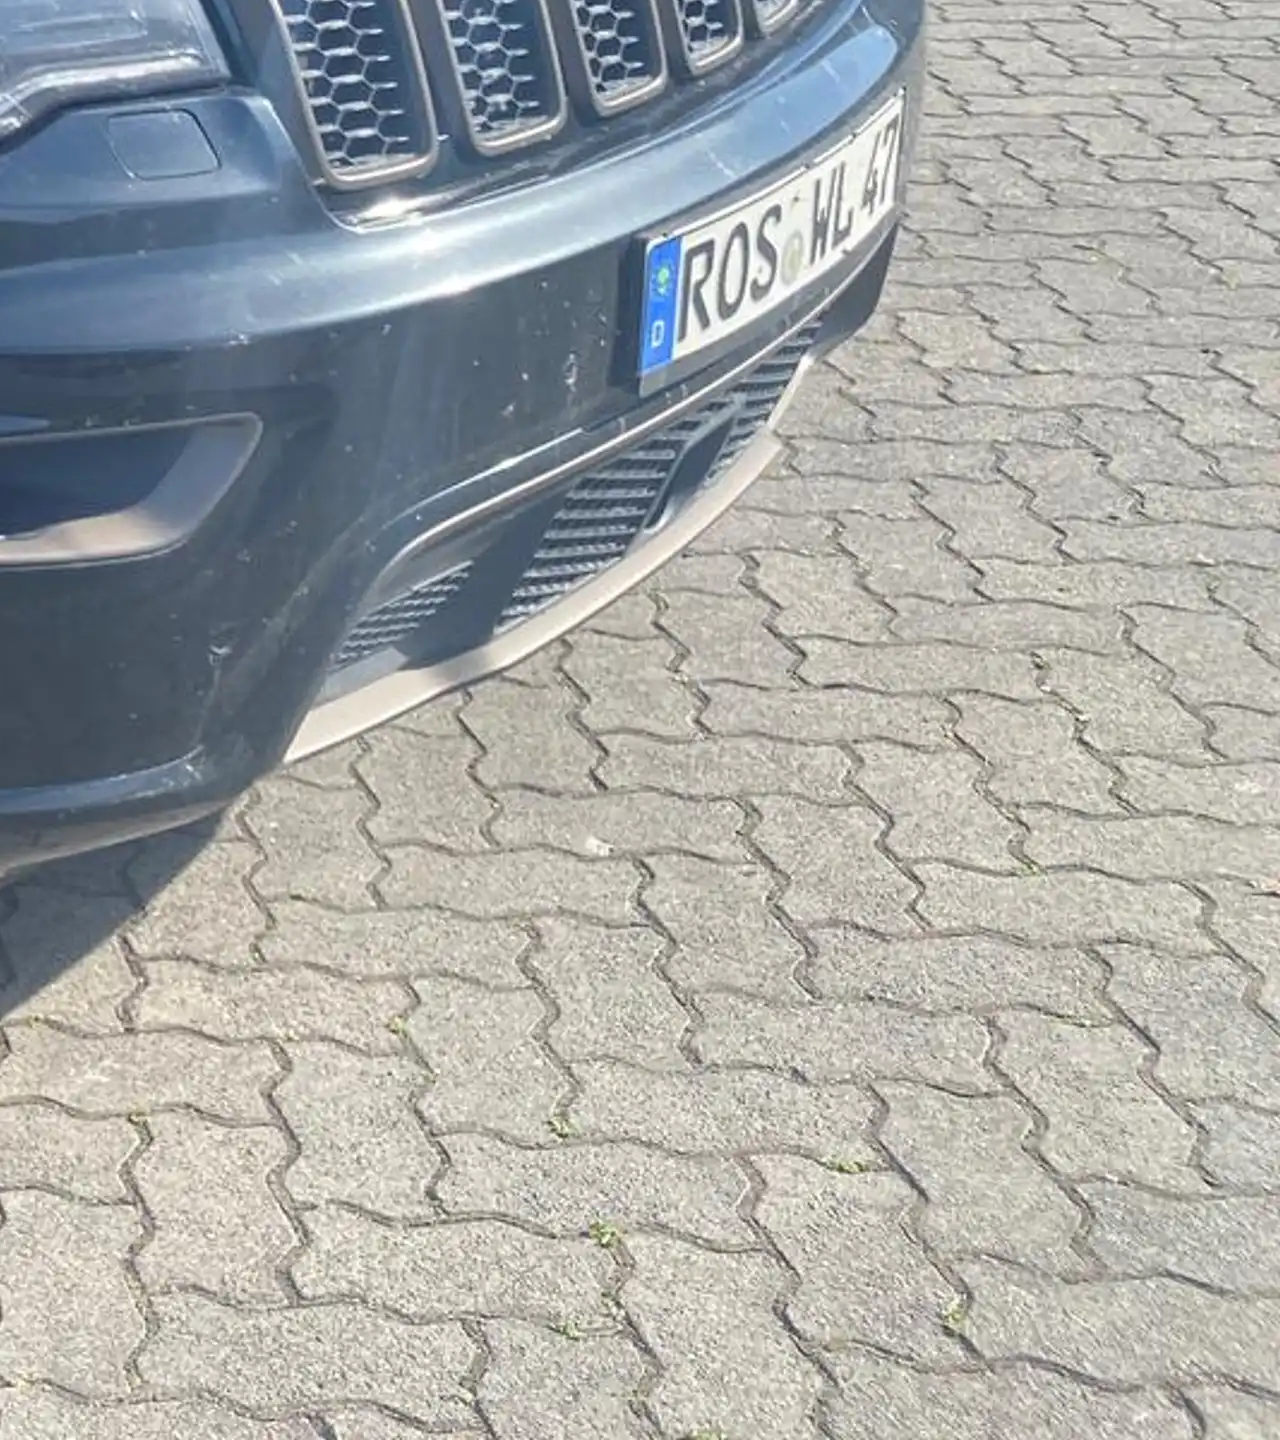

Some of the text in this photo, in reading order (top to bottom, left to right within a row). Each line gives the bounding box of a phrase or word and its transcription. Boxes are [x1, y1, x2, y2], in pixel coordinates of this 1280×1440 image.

[678, 113, 900, 343] ROS WL 47
[651, 320, 665, 348] D
